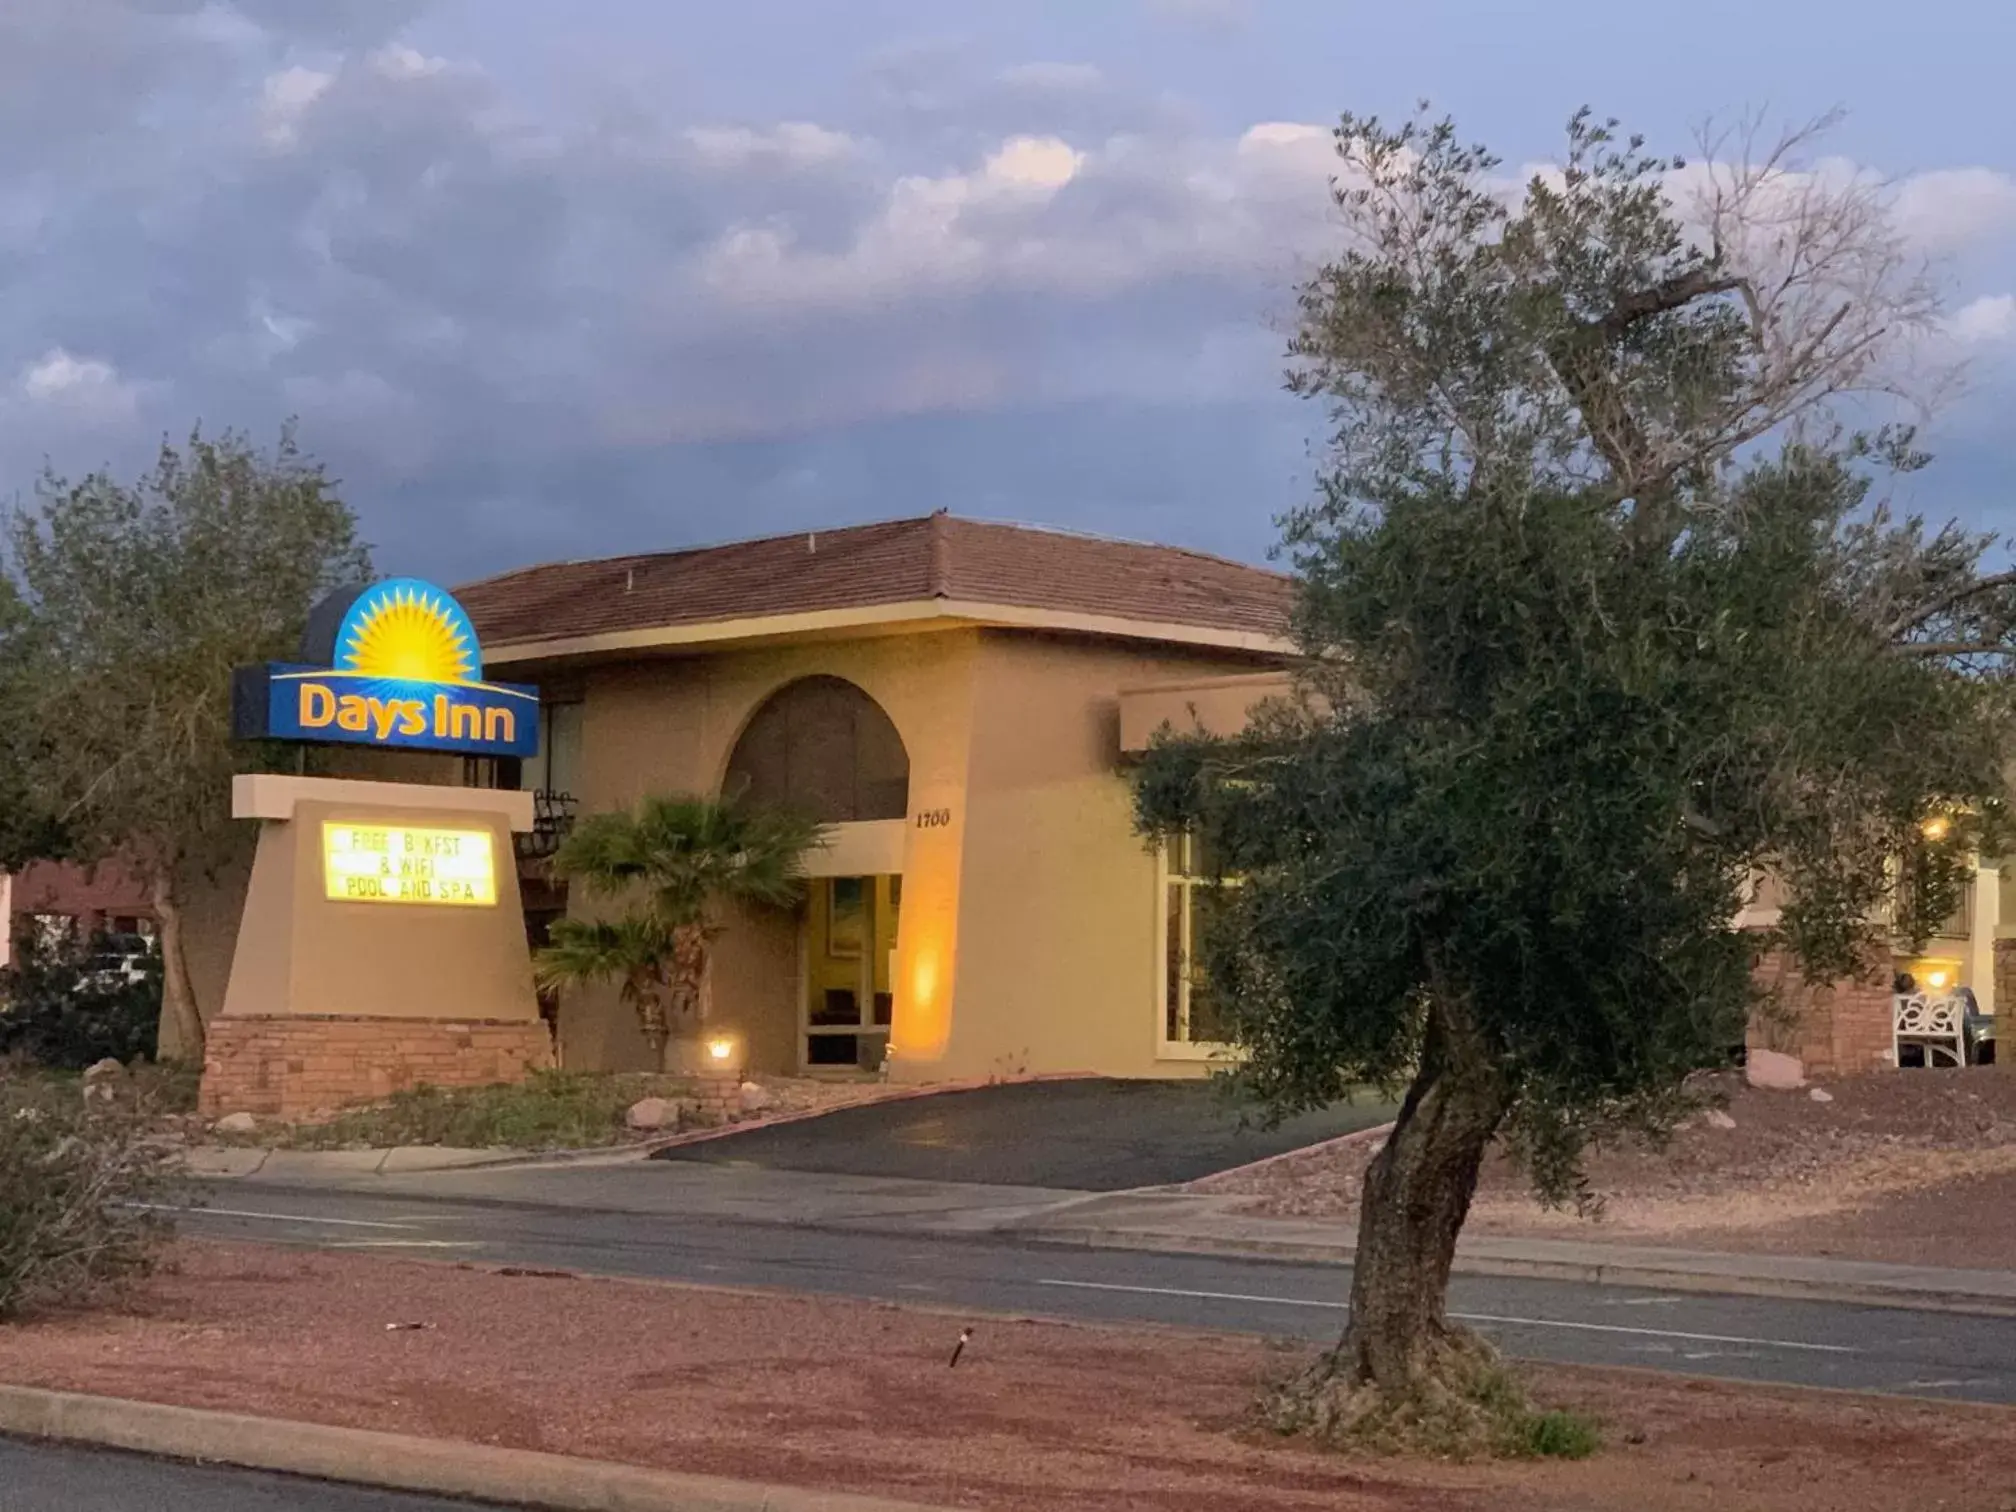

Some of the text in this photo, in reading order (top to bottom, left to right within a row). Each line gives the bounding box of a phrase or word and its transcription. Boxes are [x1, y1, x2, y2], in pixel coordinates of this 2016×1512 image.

[299, 683, 516, 743] Days Inn
[916, 808, 951, 829] 1700
[380, 856, 434, 877] & WIFI
[346, 877, 475, 901] POOL AND SPA
